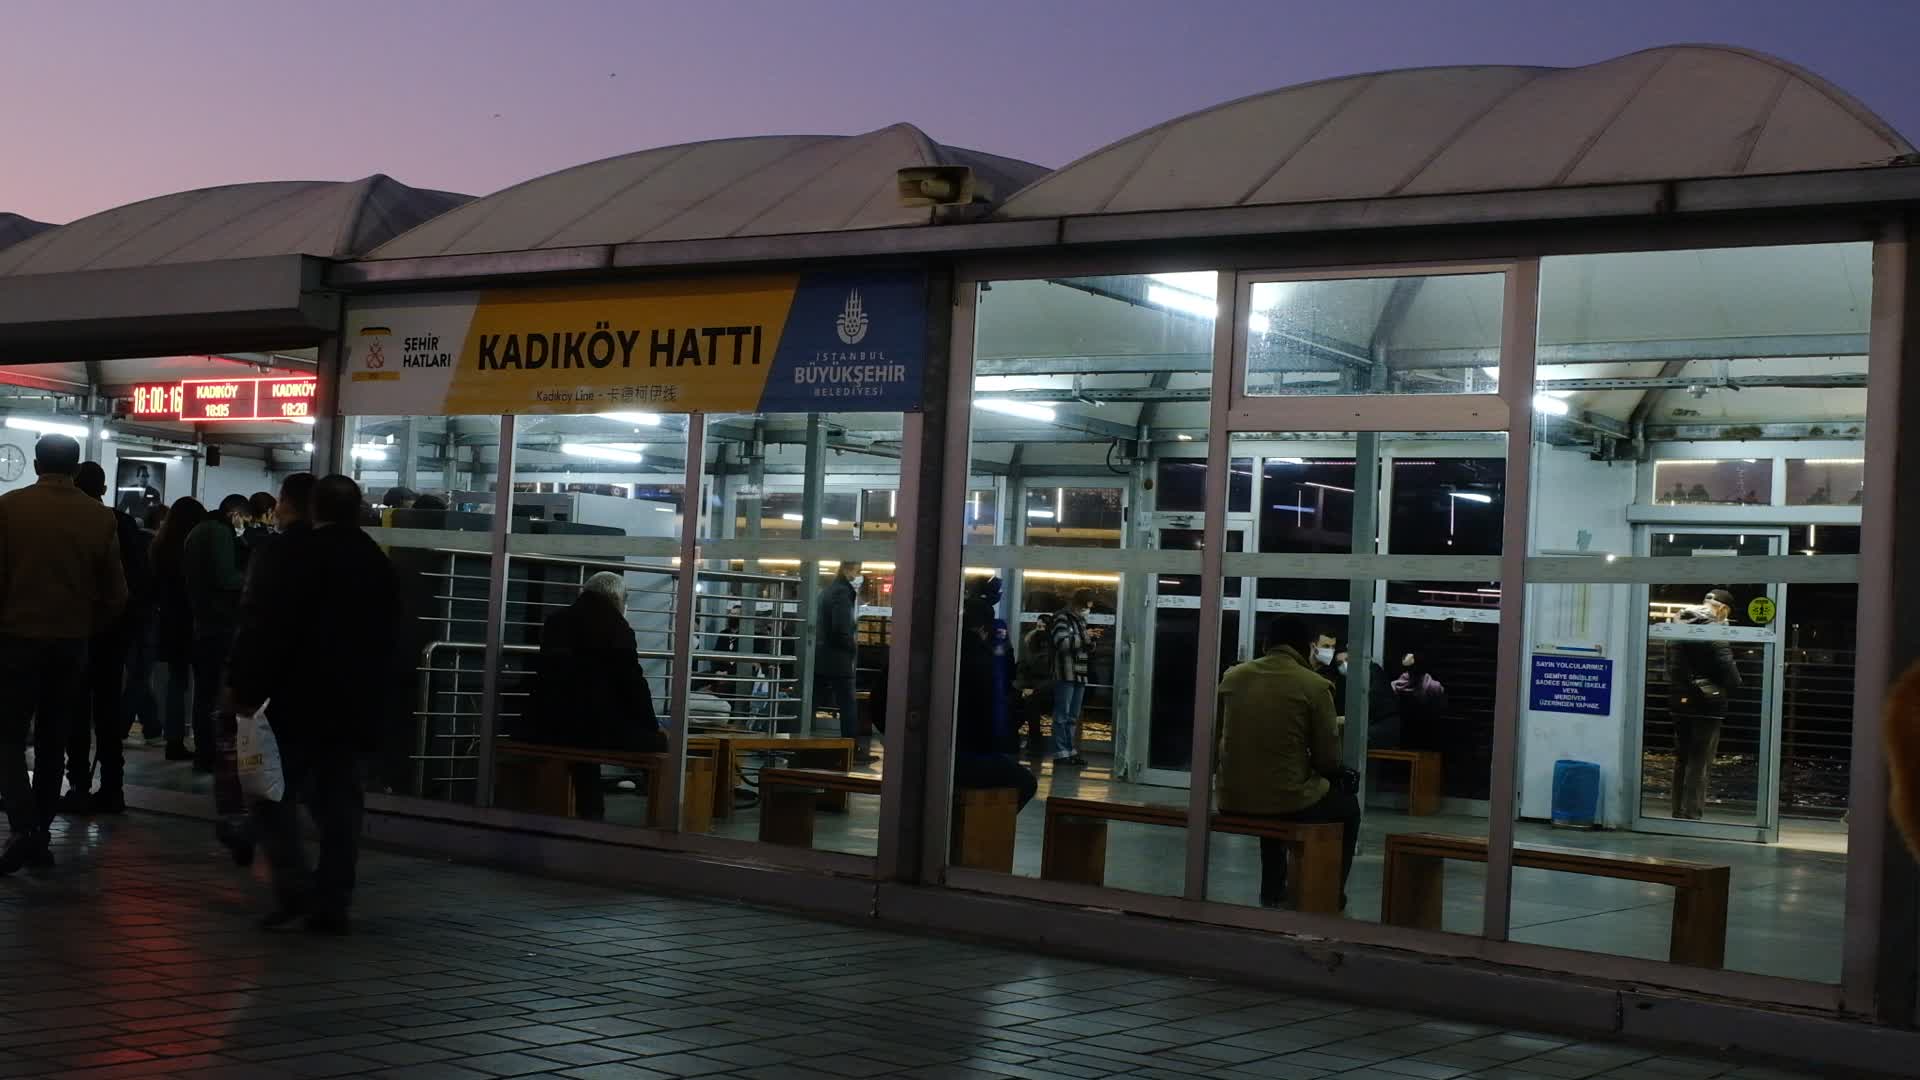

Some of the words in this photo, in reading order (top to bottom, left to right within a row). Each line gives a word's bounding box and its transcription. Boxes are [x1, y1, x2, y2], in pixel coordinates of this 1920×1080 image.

[404, 331, 440, 353] ŞEHİR
[478, 321, 640, 370] KADIKÖY
[650, 326, 762, 368] HATTI
[403, 353, 451, 368] HATLARI
[794, 360, 905, 388] BÜYÜKŞEHİR
[197, 383, 239, 398] KADIKÖY
[272, 381, 316, 397] KADIKÖY
[575, 390, 594, 402] Line
